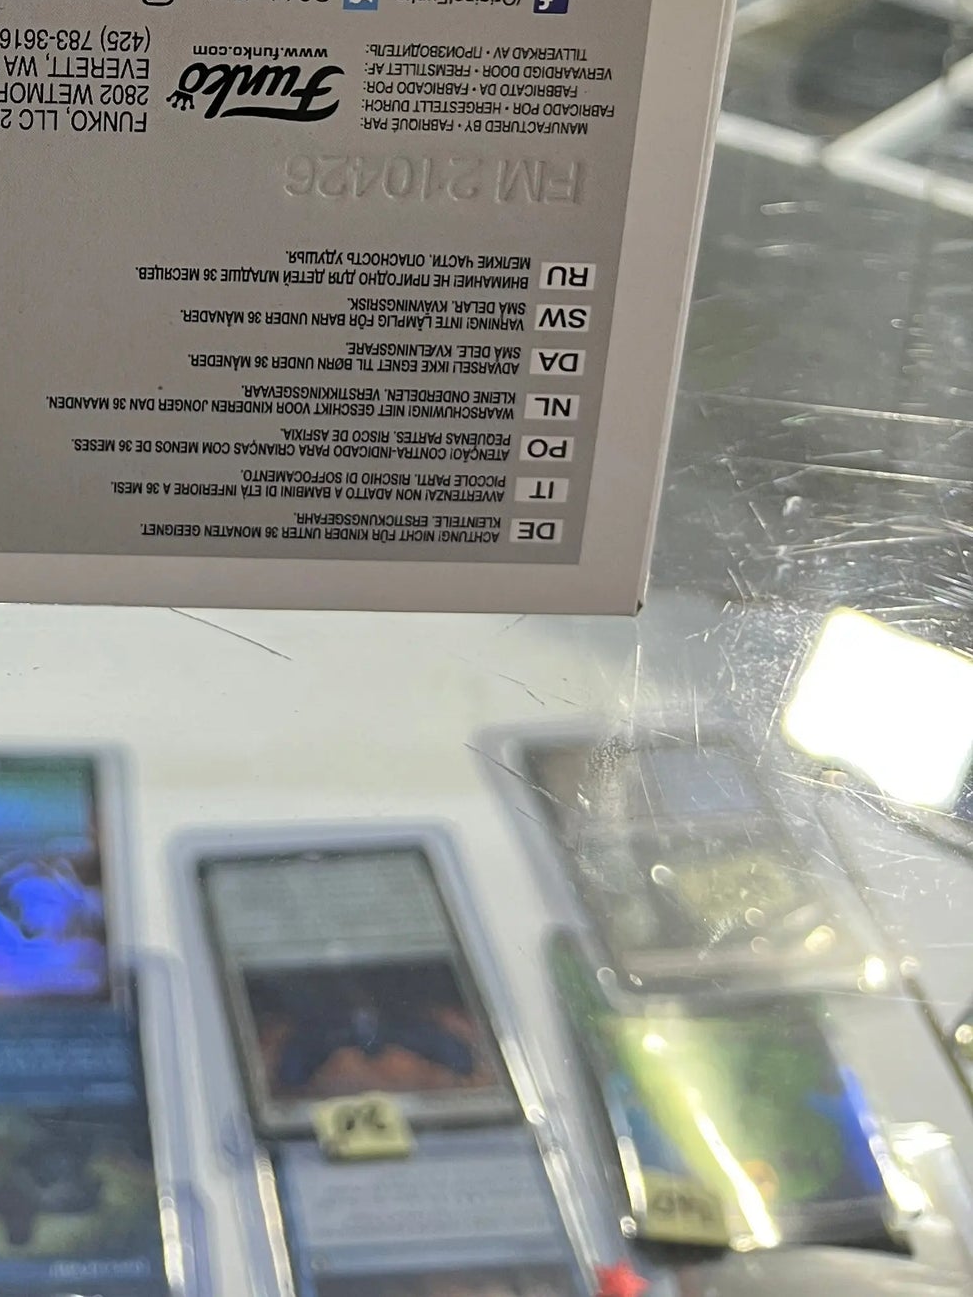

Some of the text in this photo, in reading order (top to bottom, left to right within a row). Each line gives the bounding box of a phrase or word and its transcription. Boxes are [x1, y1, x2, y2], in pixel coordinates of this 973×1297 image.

[99, 24, 151, 53] (425)
[192, 44, 328, 61] www.funko.com
[365, 42, 587, 61] TILLVERKAD AV ПРОИЗВОДИТЕЛЬ:
[2, 54, 38, 77] WA
[45, 51, 150, 79] EVERETT,
[99, 83, 149, 106] 2802
[172, 61, 345, 121] Funko
[360, 98, 615, 118] FABRICADO POR HERGESTELLT DURCH:
[18, 108, 58, 131] LLC
[65, 105, 147, 133] FUNKO,
[284, 248, 531, 270] МЕЛКИЕ ЧАСТИ. ОПАСНОСТЬ УДУШЬЯ.
[134, 264, 529, 290] ВНИМАНИЕ! НЕ ПРИГОДНО ДЛЯ ДЕТЕЙ МЛАДШЕ 36 МЕСЯЦЕВ.
[545, 265, 588, 286] RU
[537, 307, 586, 328] SW
[537, 351, 578, 371] DA
[240, 384, 516, 404] KLEINE ONDERDELEN. VERSTIKKINGSGEVAAR.
[45, 395, 514, 420] WAARSCHUWING! NIET GESCHIKT VOOR KINDEREN JONGER DAN 36 MAANDEN.
[533, 396, 571, 416] NL
[526, 437, 567, 457] PO
[527, 480, 554, 498] IT
[139, 522, 201, 537] GEEIGNET.
[293, 511, 501, 529] KLEINTEILE. ERSTICKUNGSGEFAHR.
[516, 520, 555, 539] DE
[203, 524, 262, 538] MONATEN
[264, 525, 279, 538] 36
[280, 526, 321, 539] UNTER
[323, 526, 369, 541] KINDER
[398, 529, 435, 542] NICHT
[437, 529, 500, 543] ACHTUNG!
